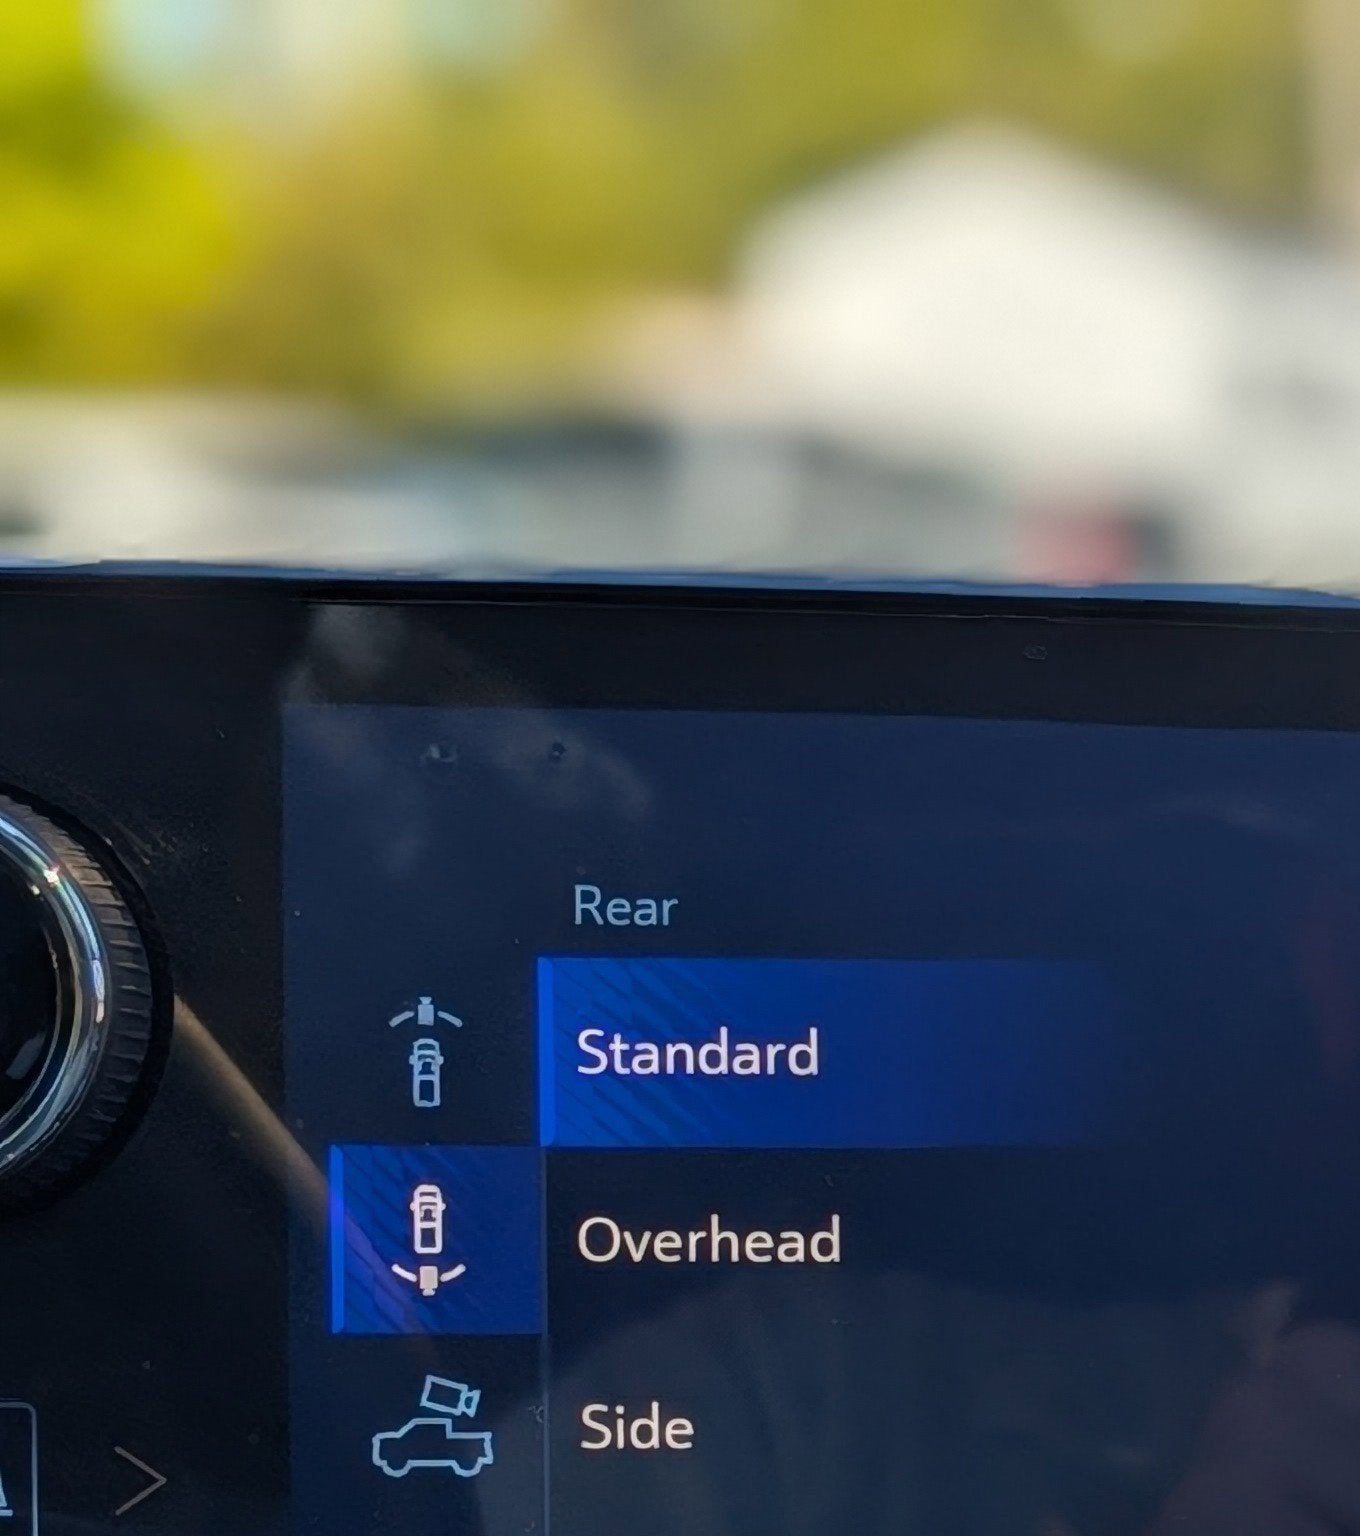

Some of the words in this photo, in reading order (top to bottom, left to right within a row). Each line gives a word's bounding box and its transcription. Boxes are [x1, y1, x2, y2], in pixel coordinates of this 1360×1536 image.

[574, 884, 679, 926] Rear
[577, 1026, 818, 1076] Standard
[578, 1213, 840, 1263] Overhead
[580, 1401, 695, 1450] Side
